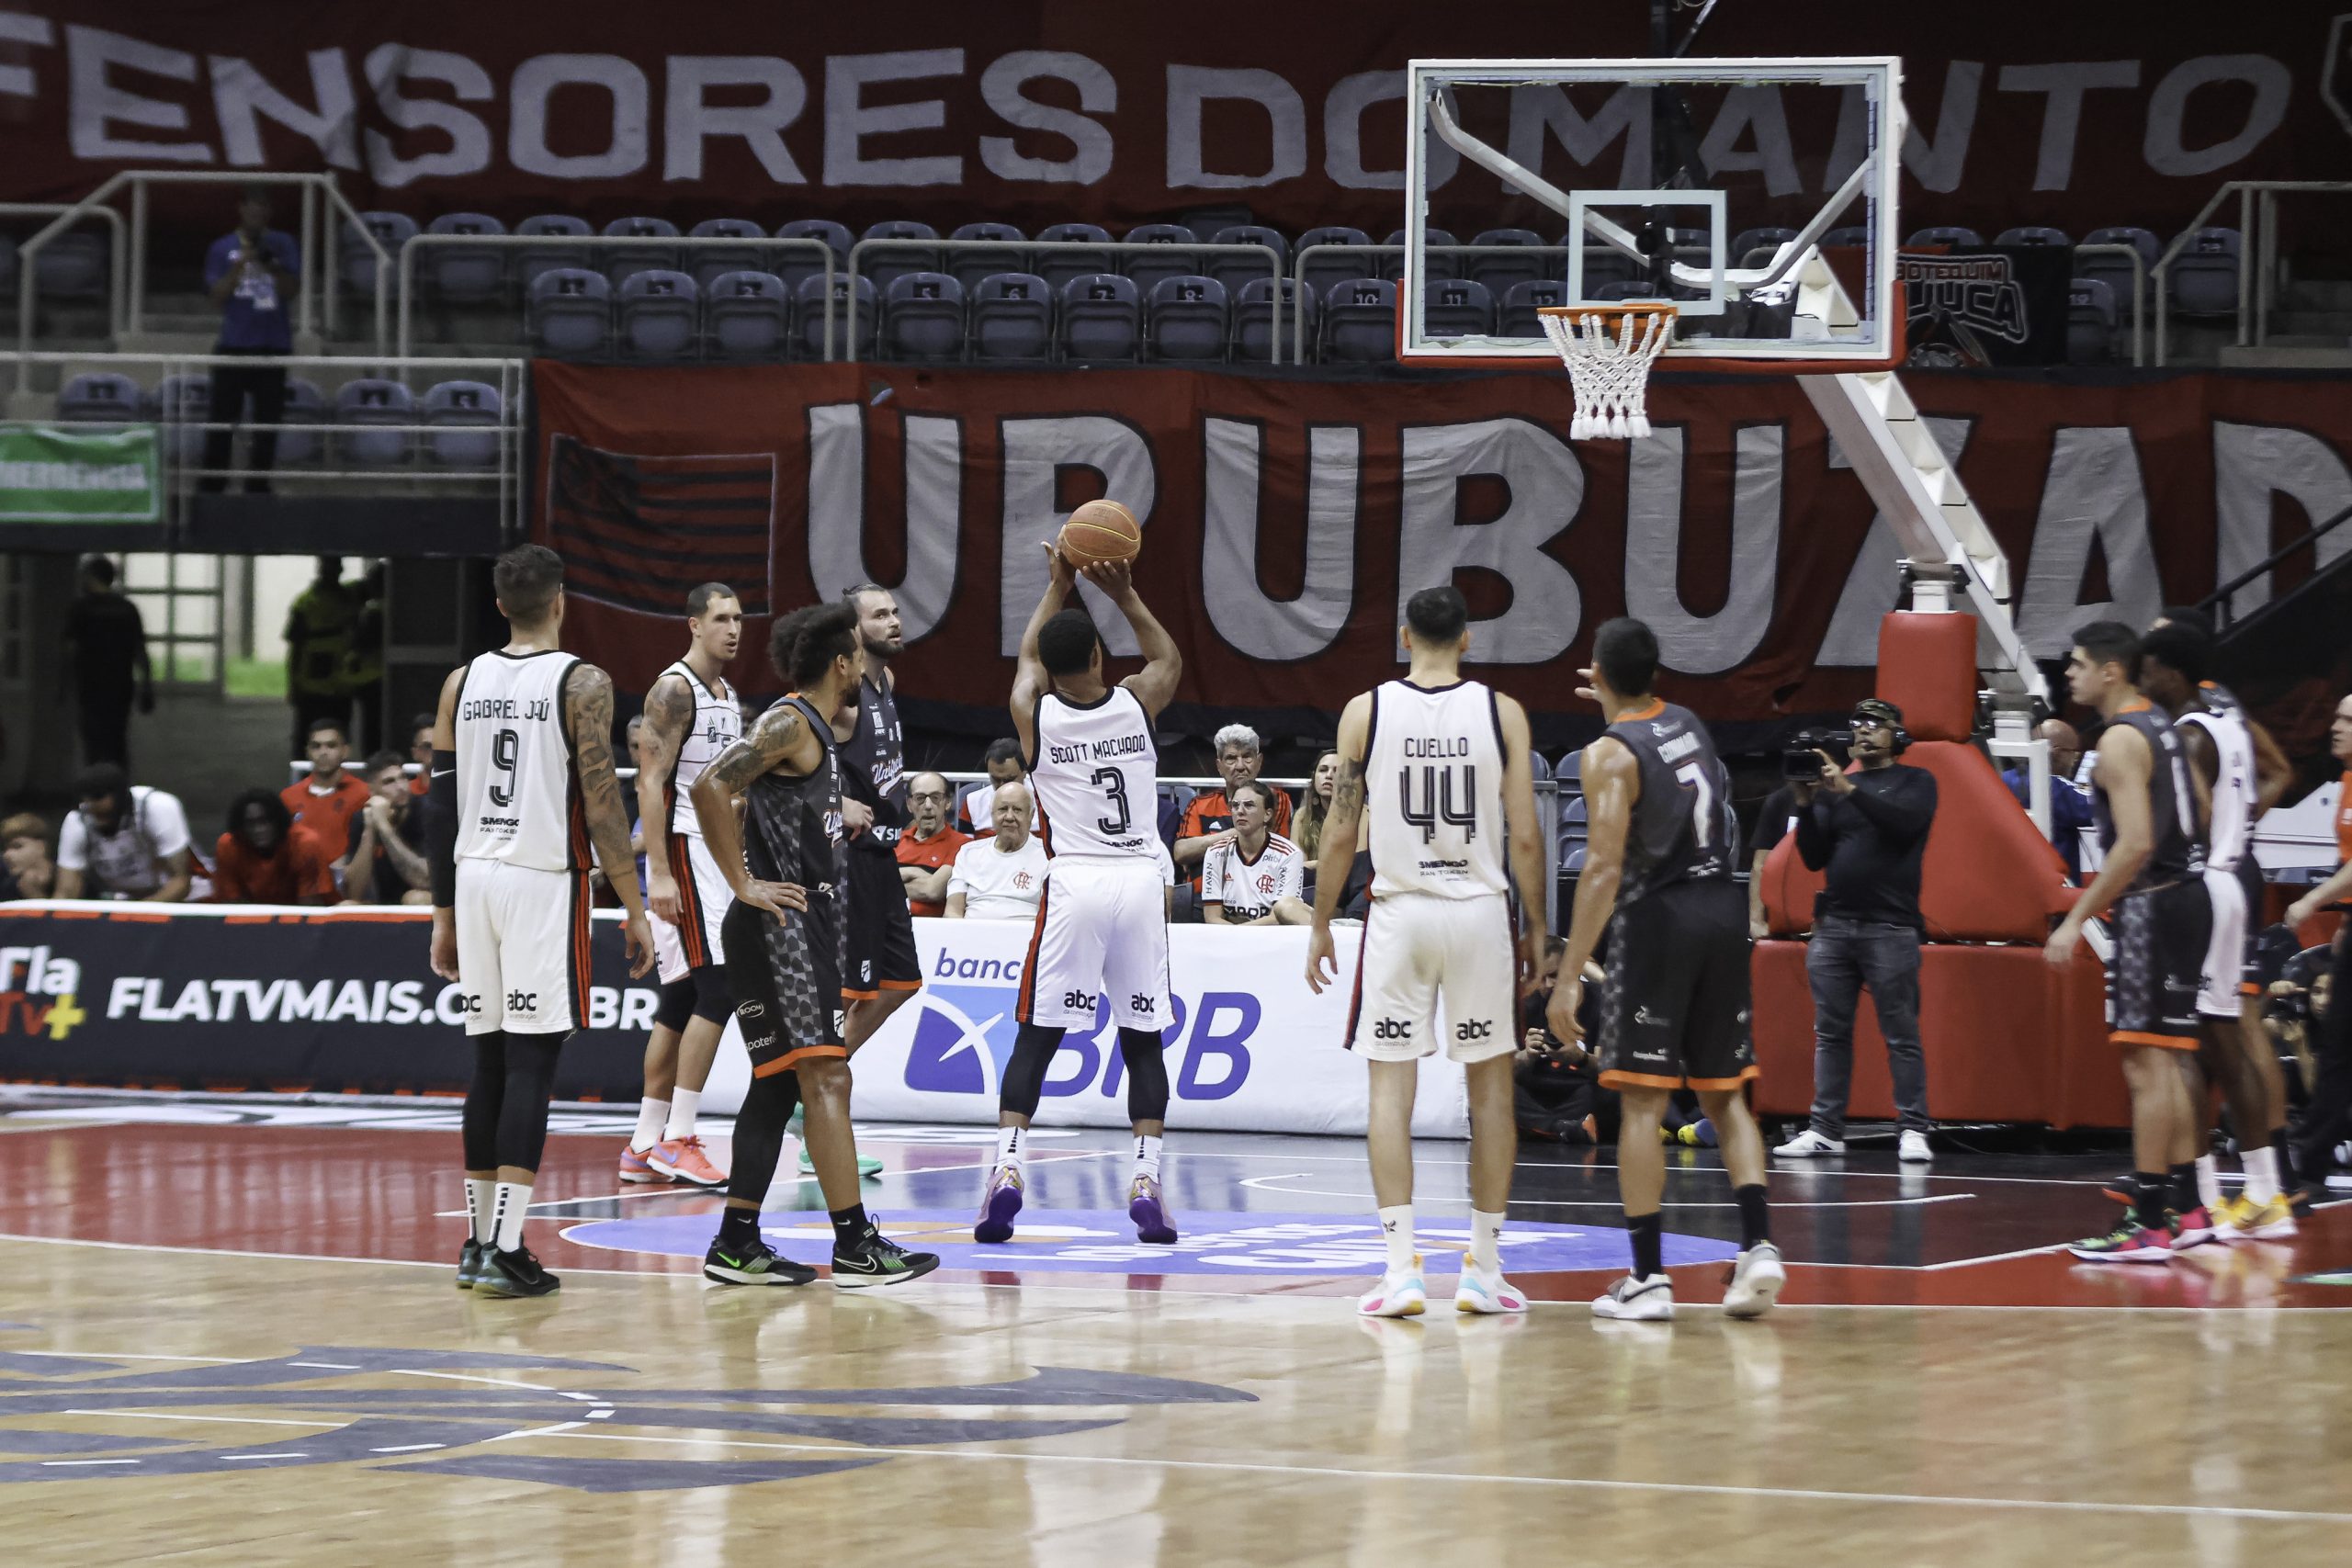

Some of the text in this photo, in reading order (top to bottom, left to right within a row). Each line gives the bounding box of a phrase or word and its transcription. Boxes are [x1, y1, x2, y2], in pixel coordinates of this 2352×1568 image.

[1166, 63, 1461, 190] DO
[1508, 54, 2293, 197] MANTO
[463, 699, 519, 721] GABRIEL
[1050, 734, 1146, 764] SCOTT MACHADO
[1404, 737, 1469, 758] CUELLO
[488, 728, 519, 807] 9
[1090, 766, 1131, 835] 3
[1398, 764, 1476, 844] 44
[1675, 761, 1713, 848] 7
[934, 947, 1023, 981] banc
[107, 977, 659, 1032] FLATVMAIS.CBR
[507, 988, 537, 1012] abc
[1064, 989, 1096, 1011] abc
[1374, 1016, 1411, 1039] abc
[1455, 1018, 1492, 1041] abc
